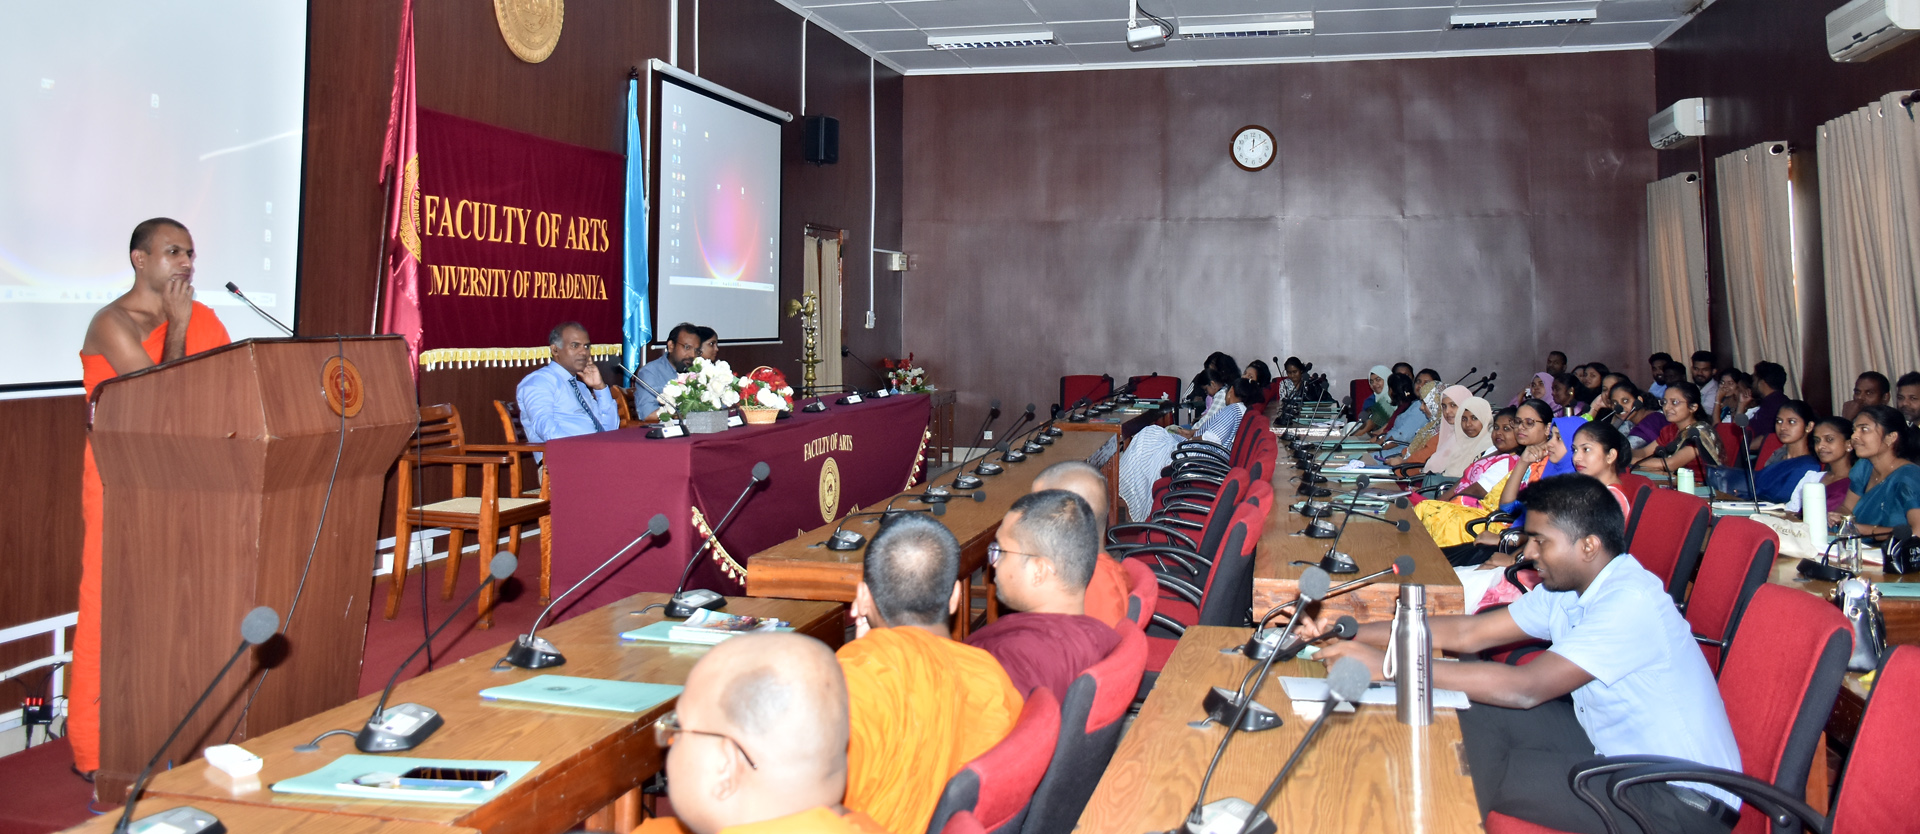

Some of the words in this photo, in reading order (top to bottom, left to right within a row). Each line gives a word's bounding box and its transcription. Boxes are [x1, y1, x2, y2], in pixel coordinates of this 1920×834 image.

[425, 194, 532, 245] FACULTY
[536, 211, 562, 248] OF
[564, 216, 609, 252] ARTS
[513, 269, 531, 298] OF
[533, 271, 609, 300] PERADENIYA
[804, 436, 830, 462] FACULTY
[830, 432, 838, 451] OF
[839, 434, 853, 451] ARTS
